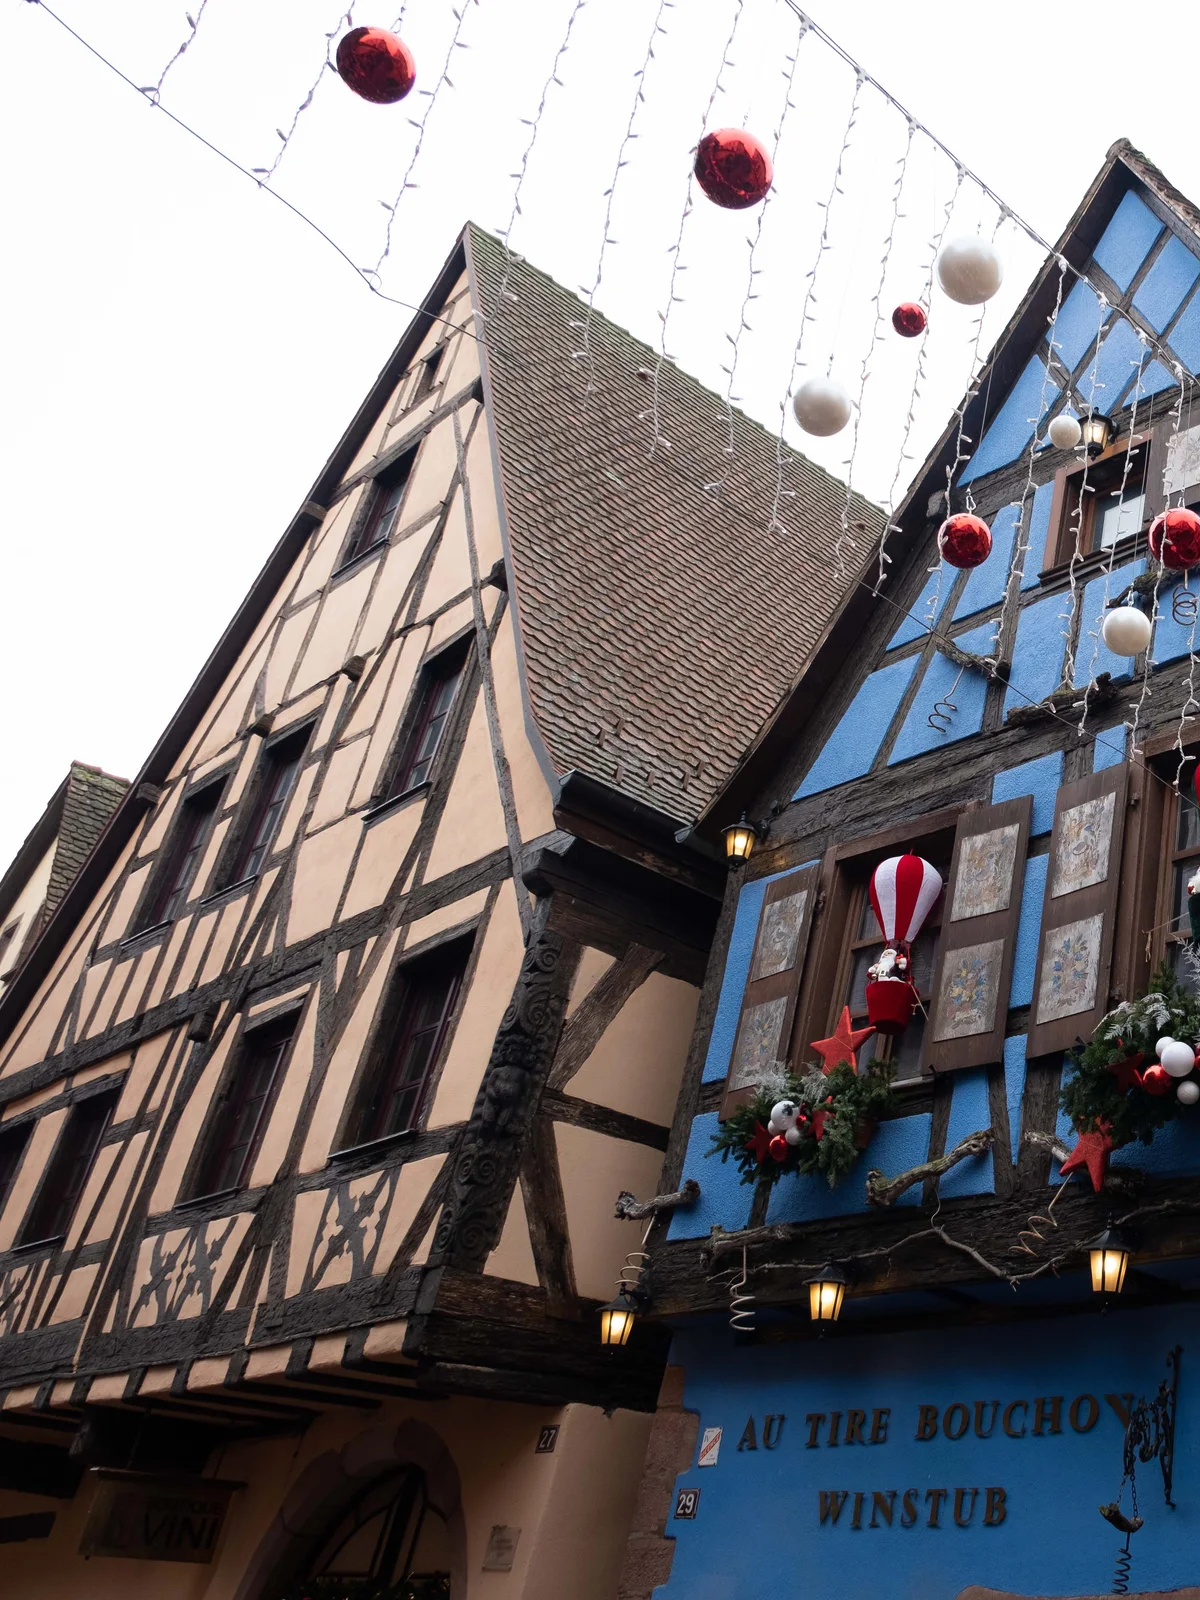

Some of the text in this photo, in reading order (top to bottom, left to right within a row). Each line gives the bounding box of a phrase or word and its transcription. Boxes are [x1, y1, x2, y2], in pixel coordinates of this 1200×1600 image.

[539, 1429, 557, 1448] 27
[737, 1413, 786, 1451] AU
[805, 1407, 892, 1448] TIRE
[677, 1493, 695, 1514] 29
[818, 1486, 1007, 1528] WINSTUB
[143, 1512, 220, 1550] VINI
